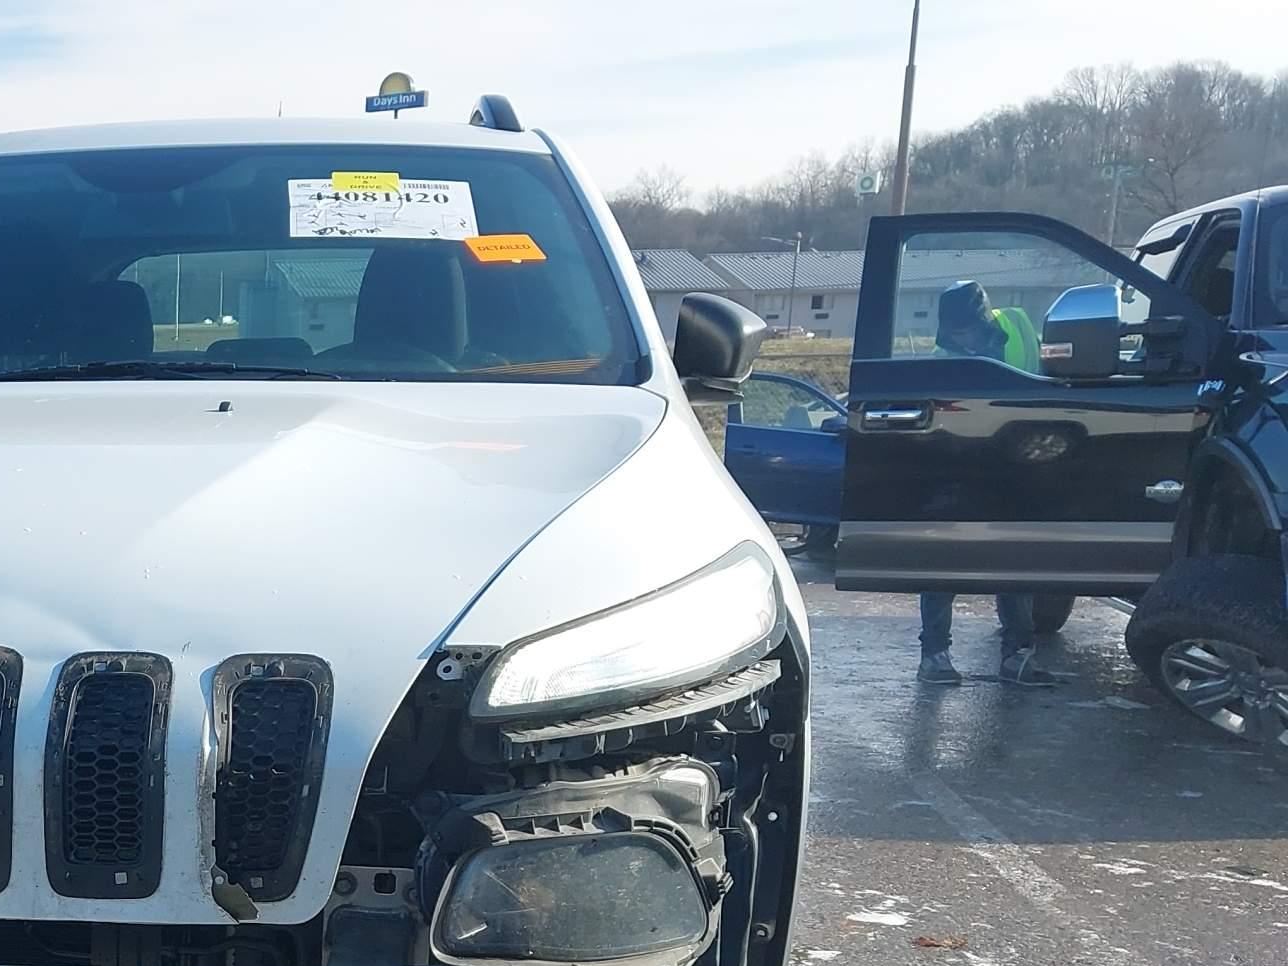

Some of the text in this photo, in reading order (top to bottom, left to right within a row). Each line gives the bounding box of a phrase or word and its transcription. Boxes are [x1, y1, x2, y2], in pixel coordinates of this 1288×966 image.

[373, 94, 416, 107] Days Inn
[309, 191, 450, 204] 44081420
